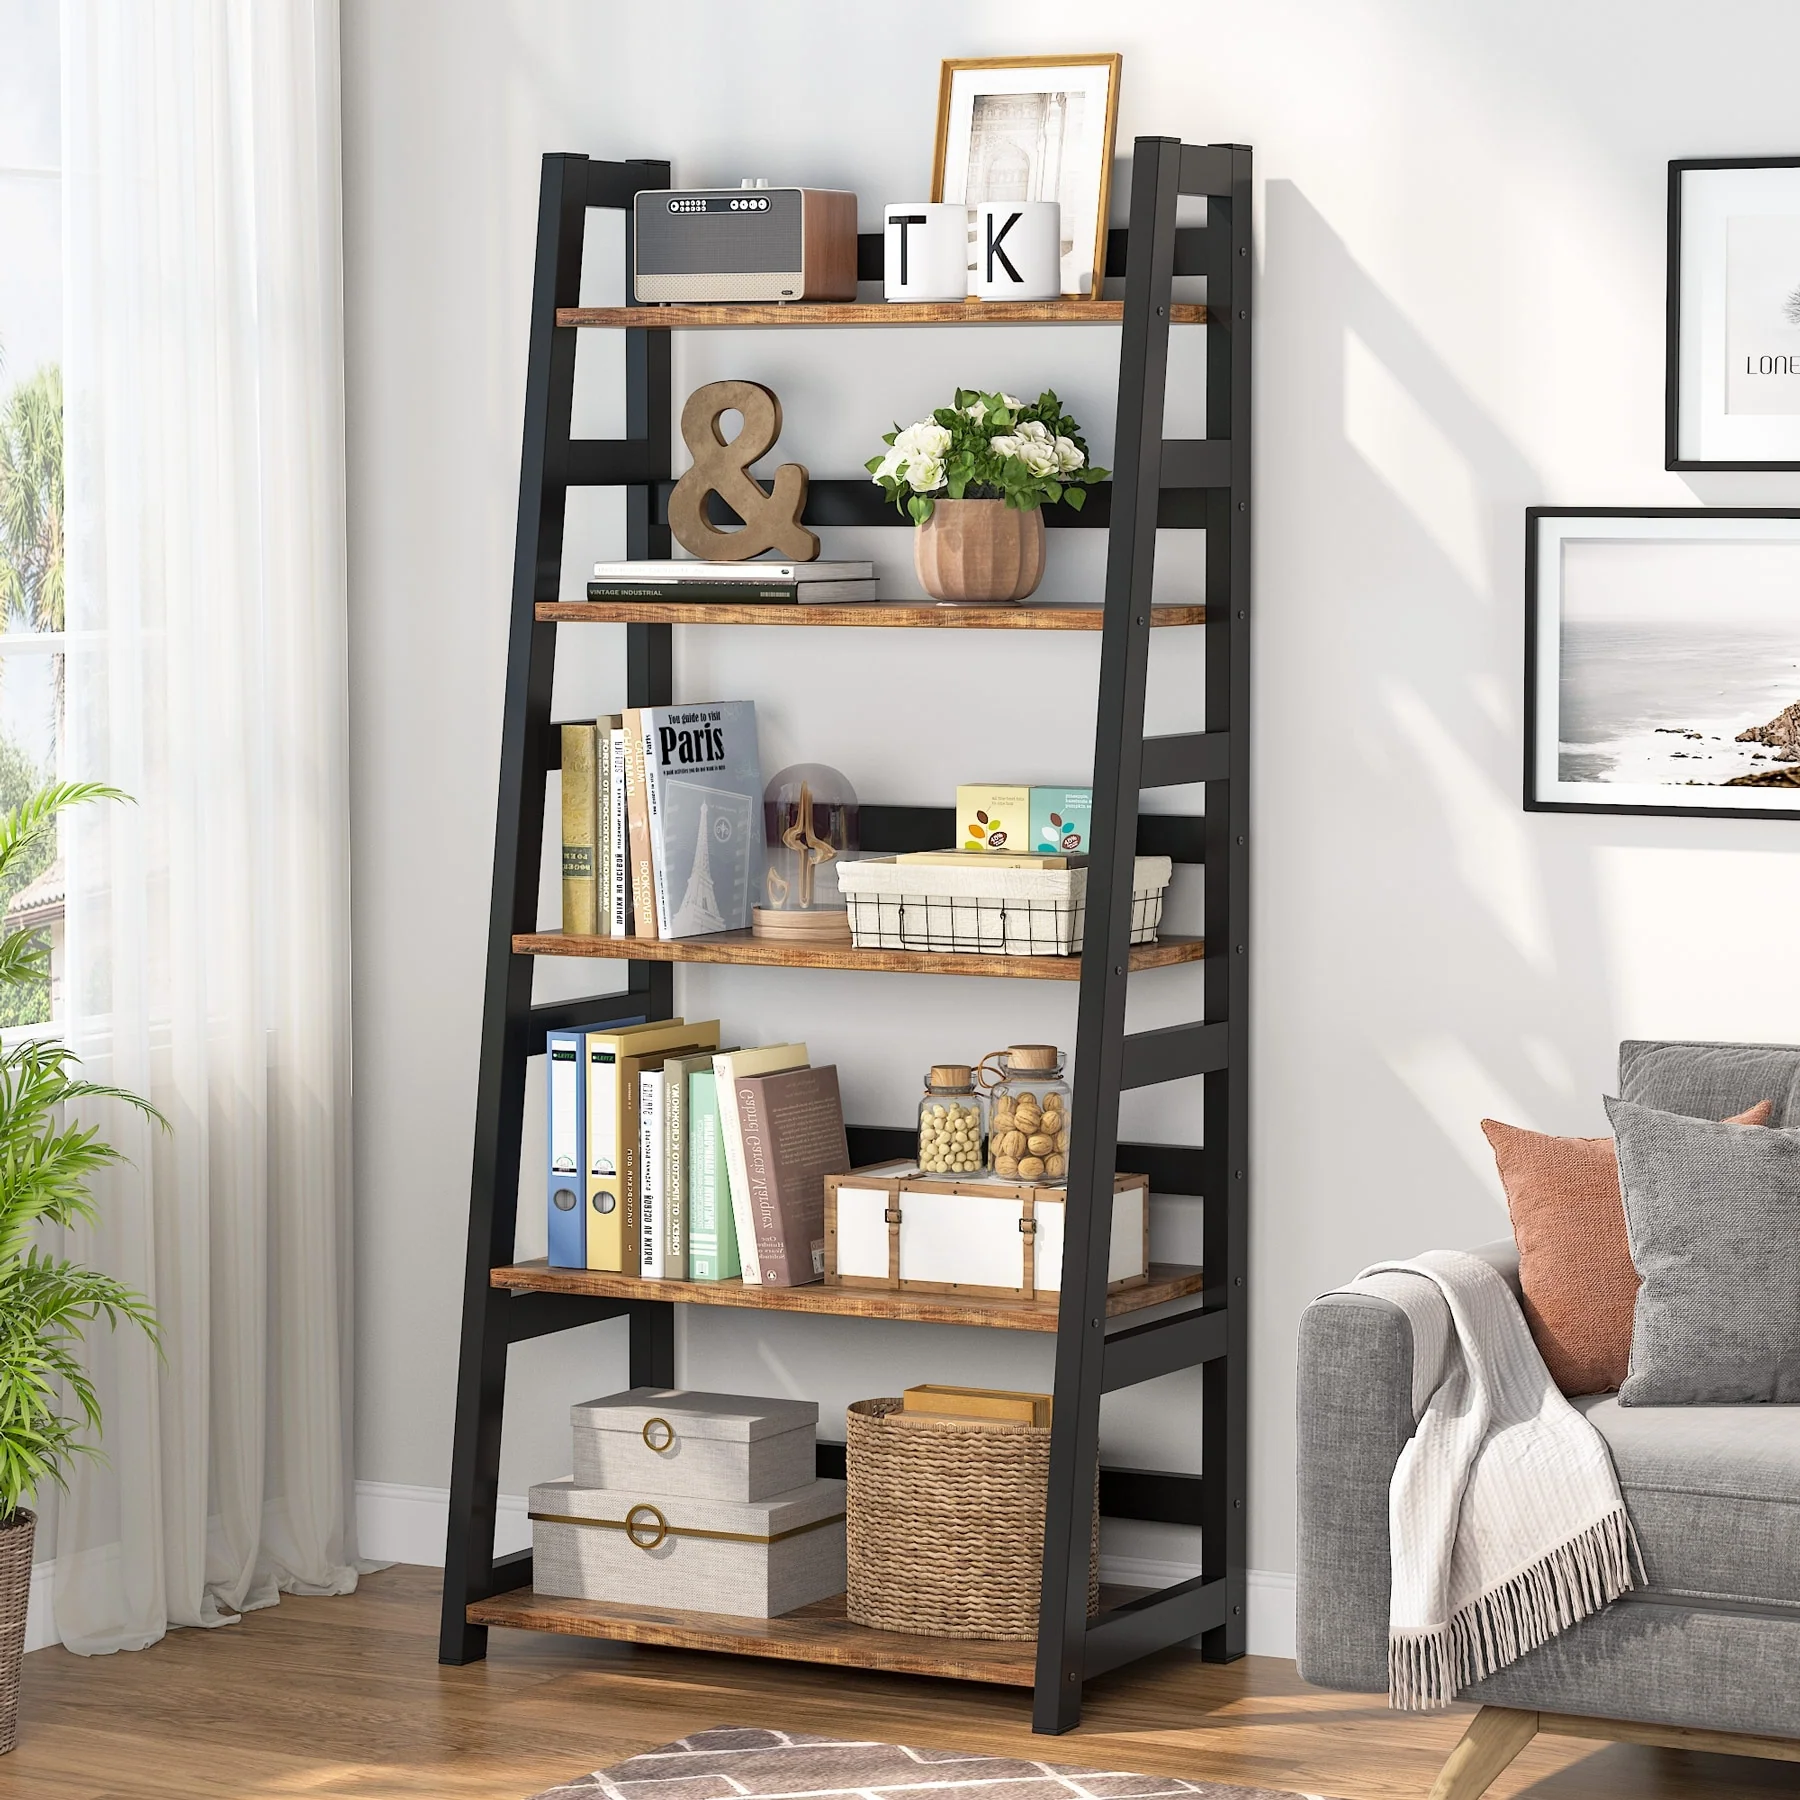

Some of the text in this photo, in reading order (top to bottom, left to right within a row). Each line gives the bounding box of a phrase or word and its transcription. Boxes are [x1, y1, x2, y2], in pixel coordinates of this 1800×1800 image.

[888, 215, 927, 286] T
[986, 212, 1024, 283] K
[668, 380, 821, 561] &
[668, 710, 721, 724] You guide to visit
[634, 740, 645, 782] CALLUM
[658, 722, 725, 766] Paris
[603, 780, 609, 794] ОТ
[616, 884, 623, 894] НА
[639, 860, 651, 924] BOOK COVER
